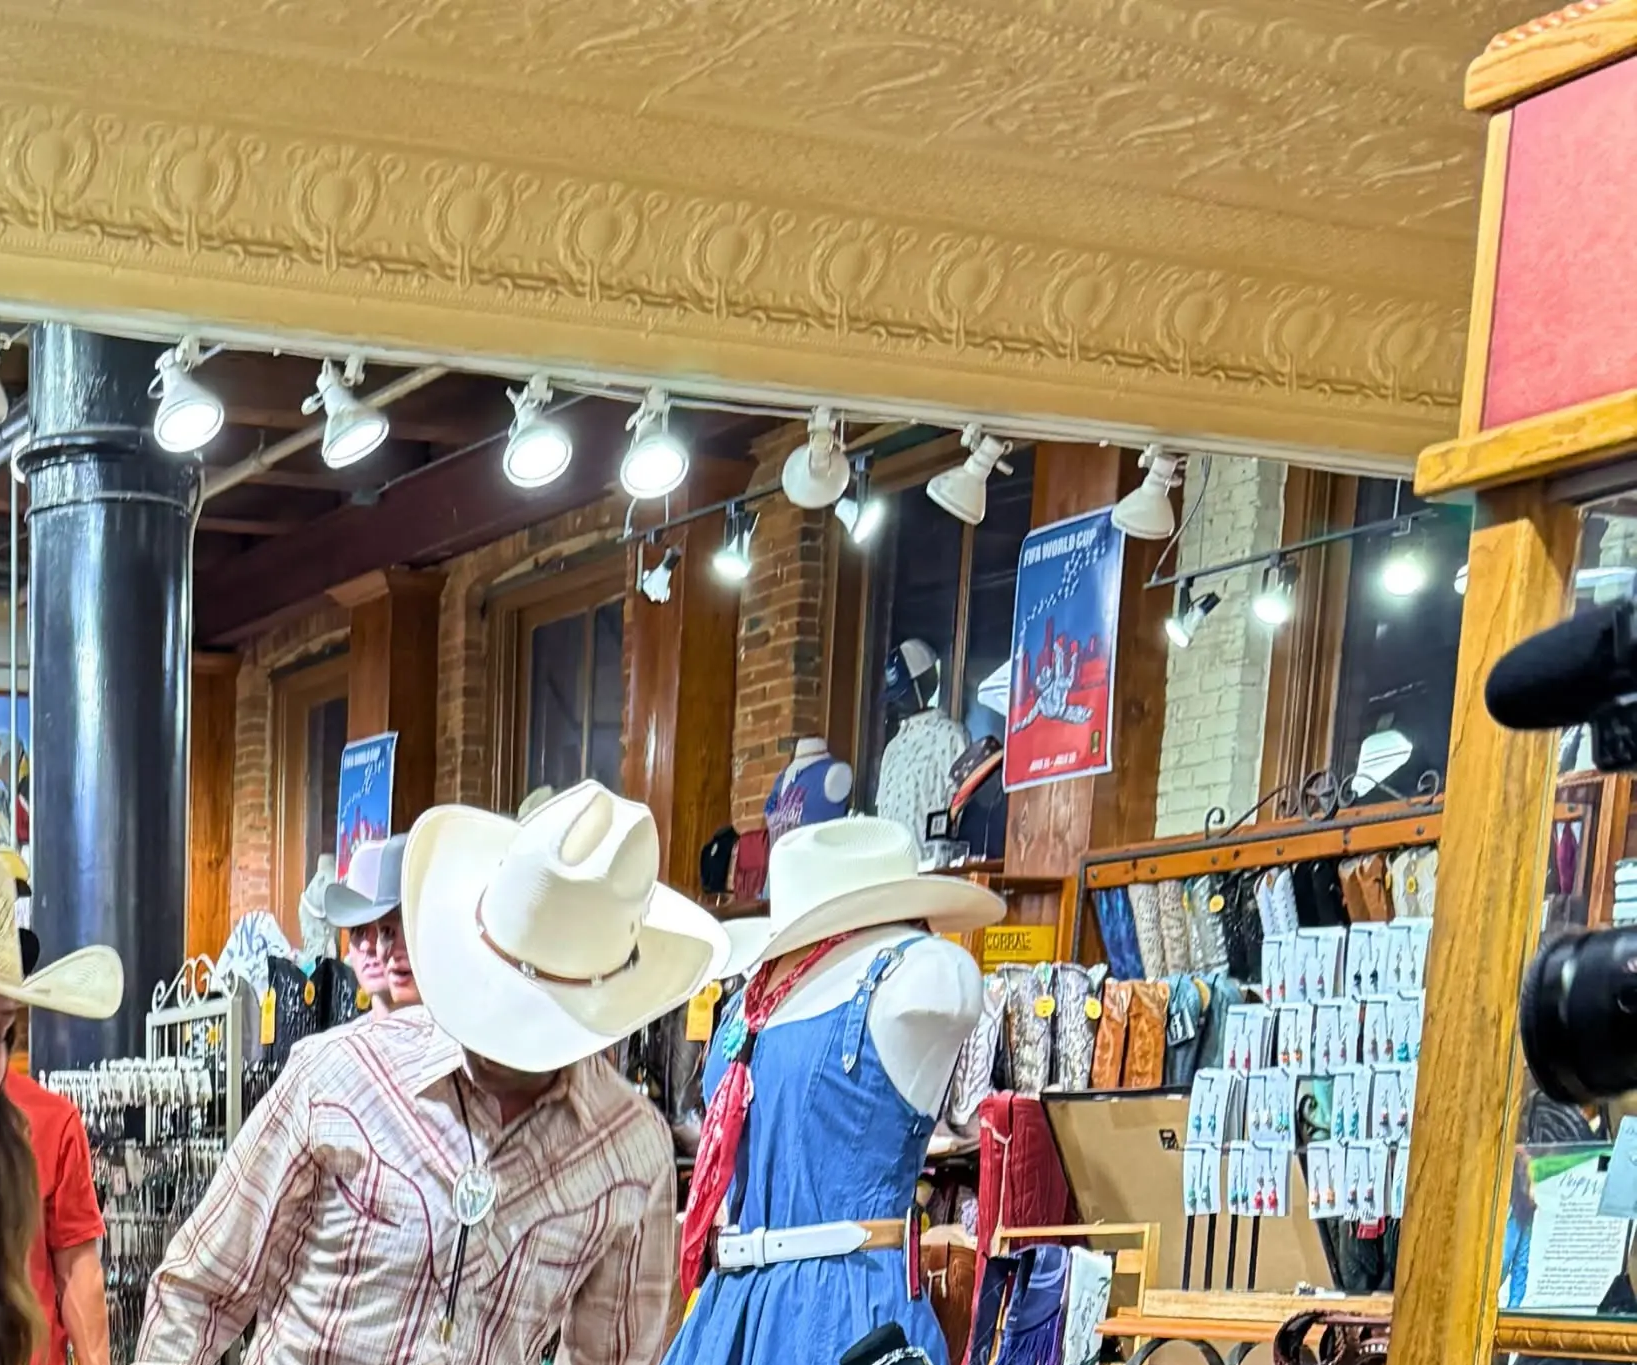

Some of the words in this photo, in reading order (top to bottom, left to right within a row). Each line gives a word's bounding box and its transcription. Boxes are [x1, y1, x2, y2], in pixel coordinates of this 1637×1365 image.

[1023, 544, 1042, 569] FIFA
[1042, 532, 1076, 560] WORLD
[1076, 527, 1098, 549] CUP
